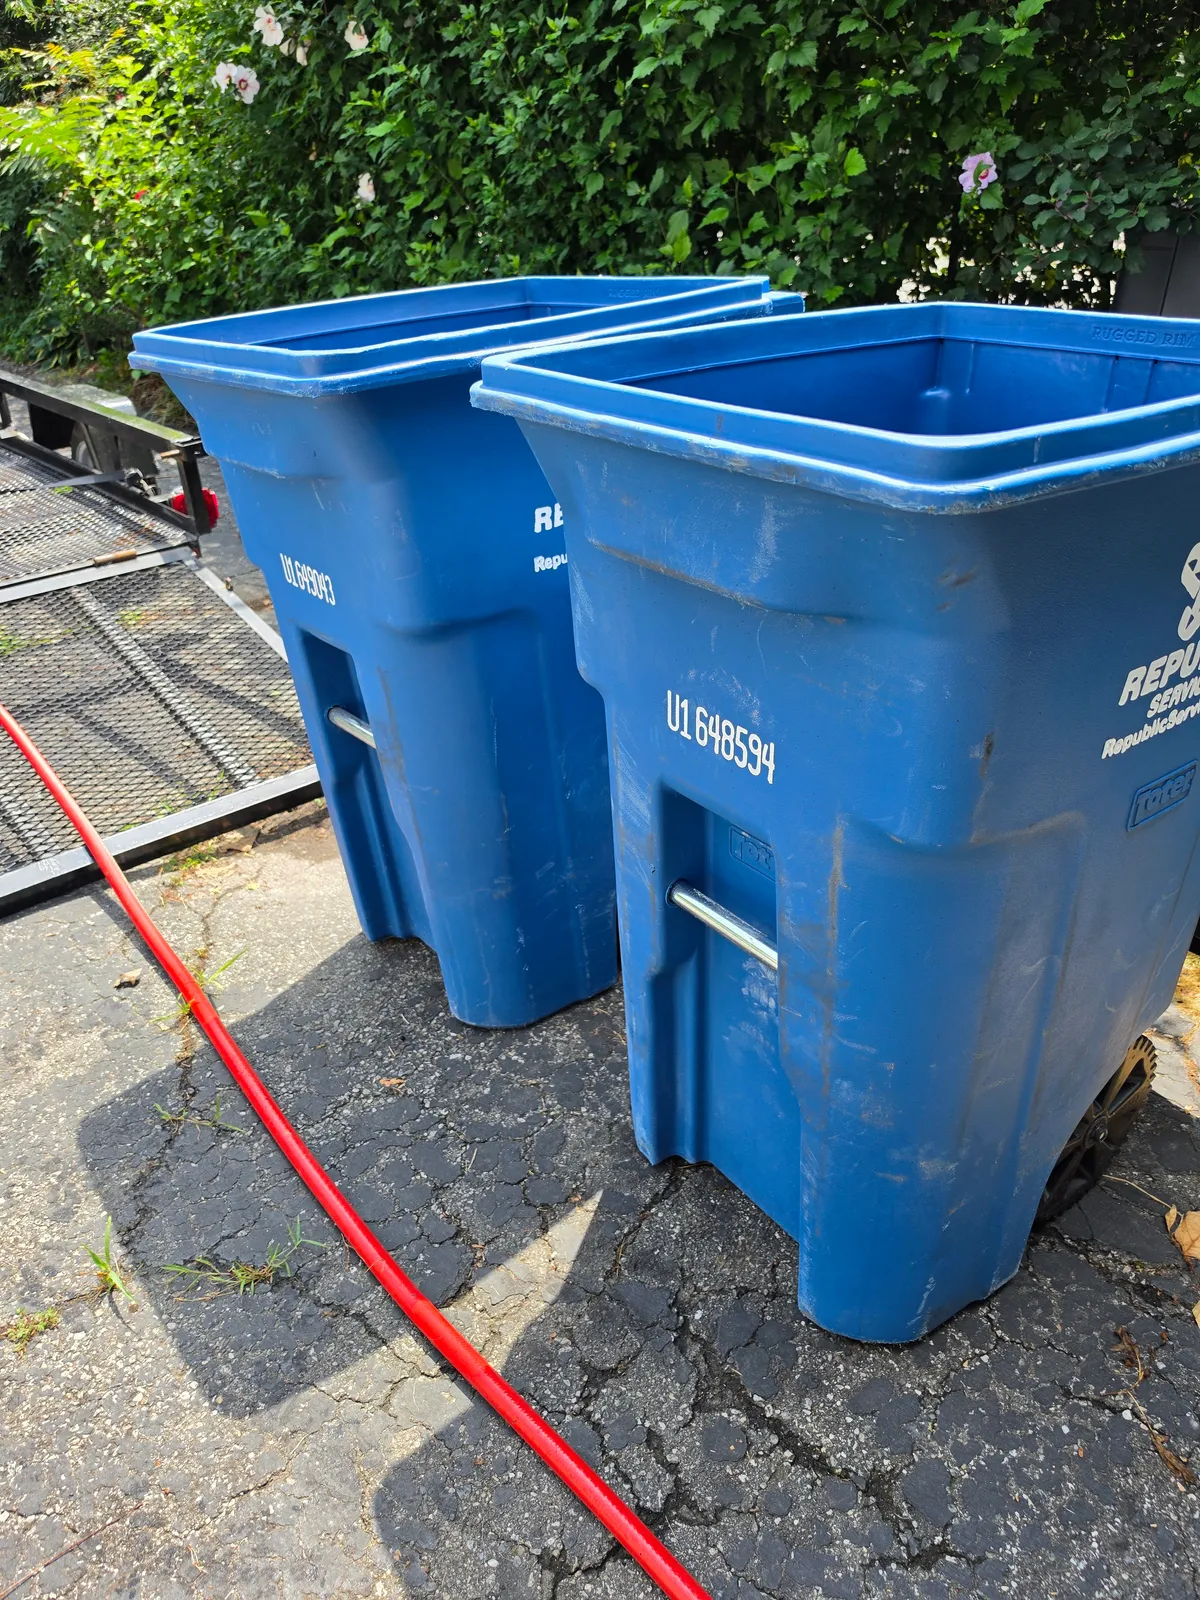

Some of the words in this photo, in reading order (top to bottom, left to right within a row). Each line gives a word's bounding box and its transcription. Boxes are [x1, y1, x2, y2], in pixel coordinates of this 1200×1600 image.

[1091, 325, 1158, 345] RUGGED
[1160, 332, 1196, 348] RIM
[1132, 767, 1196, 826] Toter
